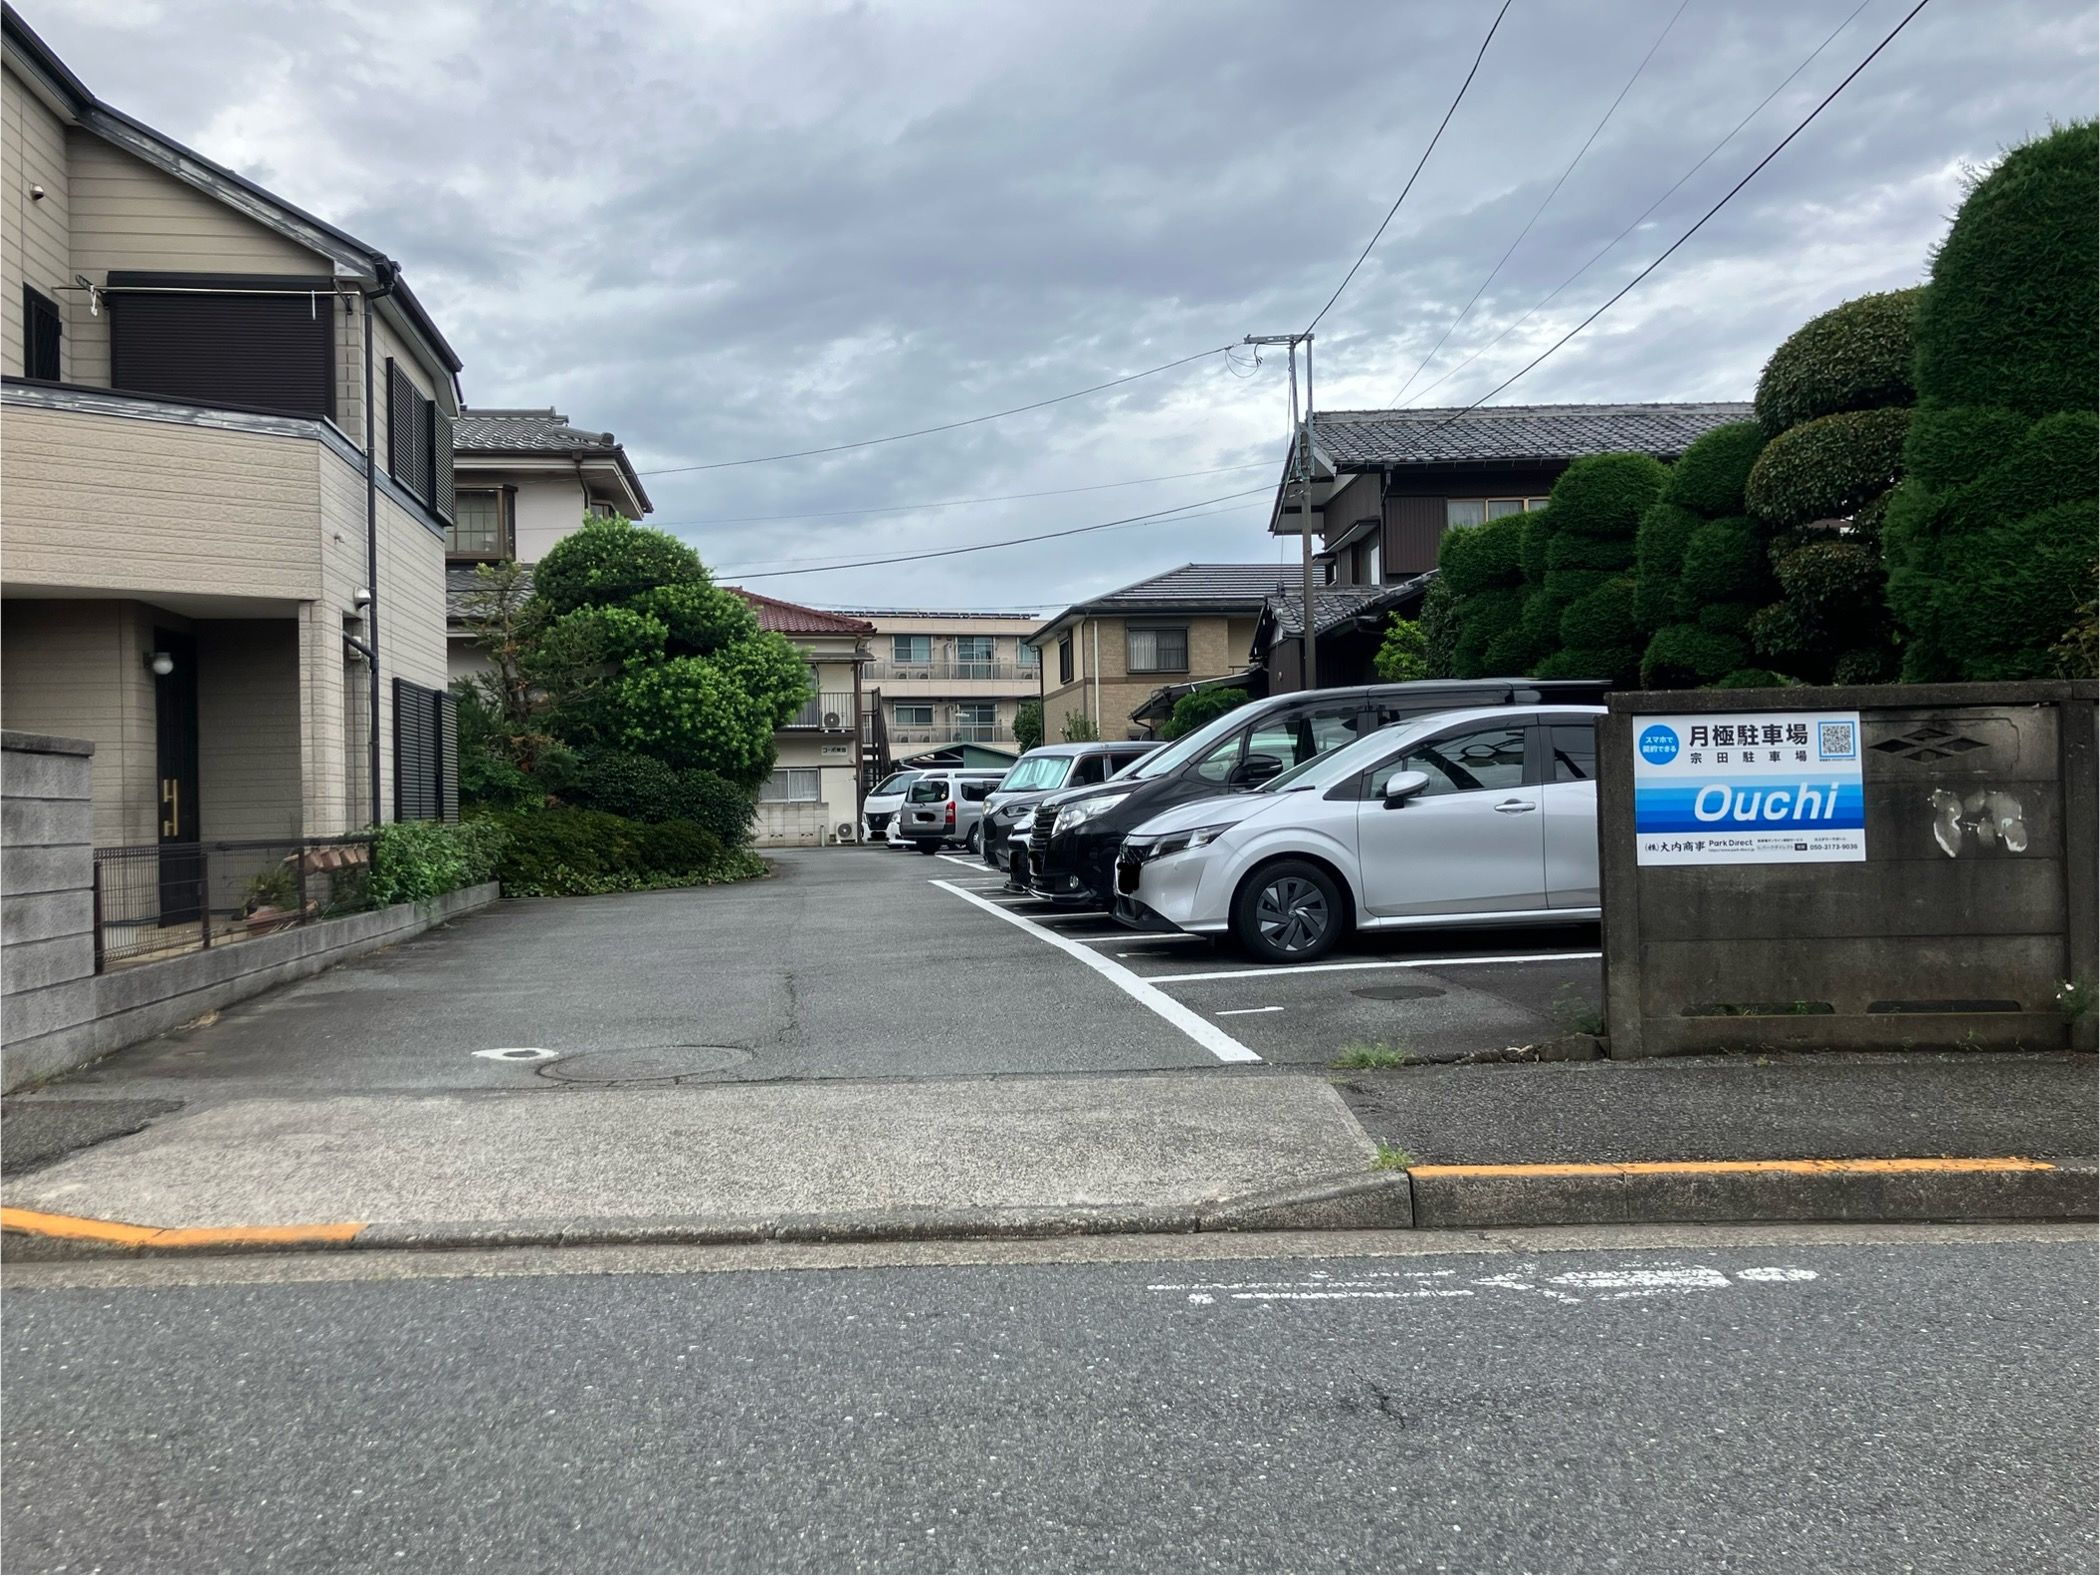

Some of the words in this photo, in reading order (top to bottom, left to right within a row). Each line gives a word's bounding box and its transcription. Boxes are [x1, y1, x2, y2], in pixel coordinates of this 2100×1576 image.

[1644, 735, 1674, 744] スマホで
[1689, 723, 1808, 747] 月極駐車場
[1694, 781, 1839, 822] Ouchi
[1728, 839, 1753, 847] Direct
